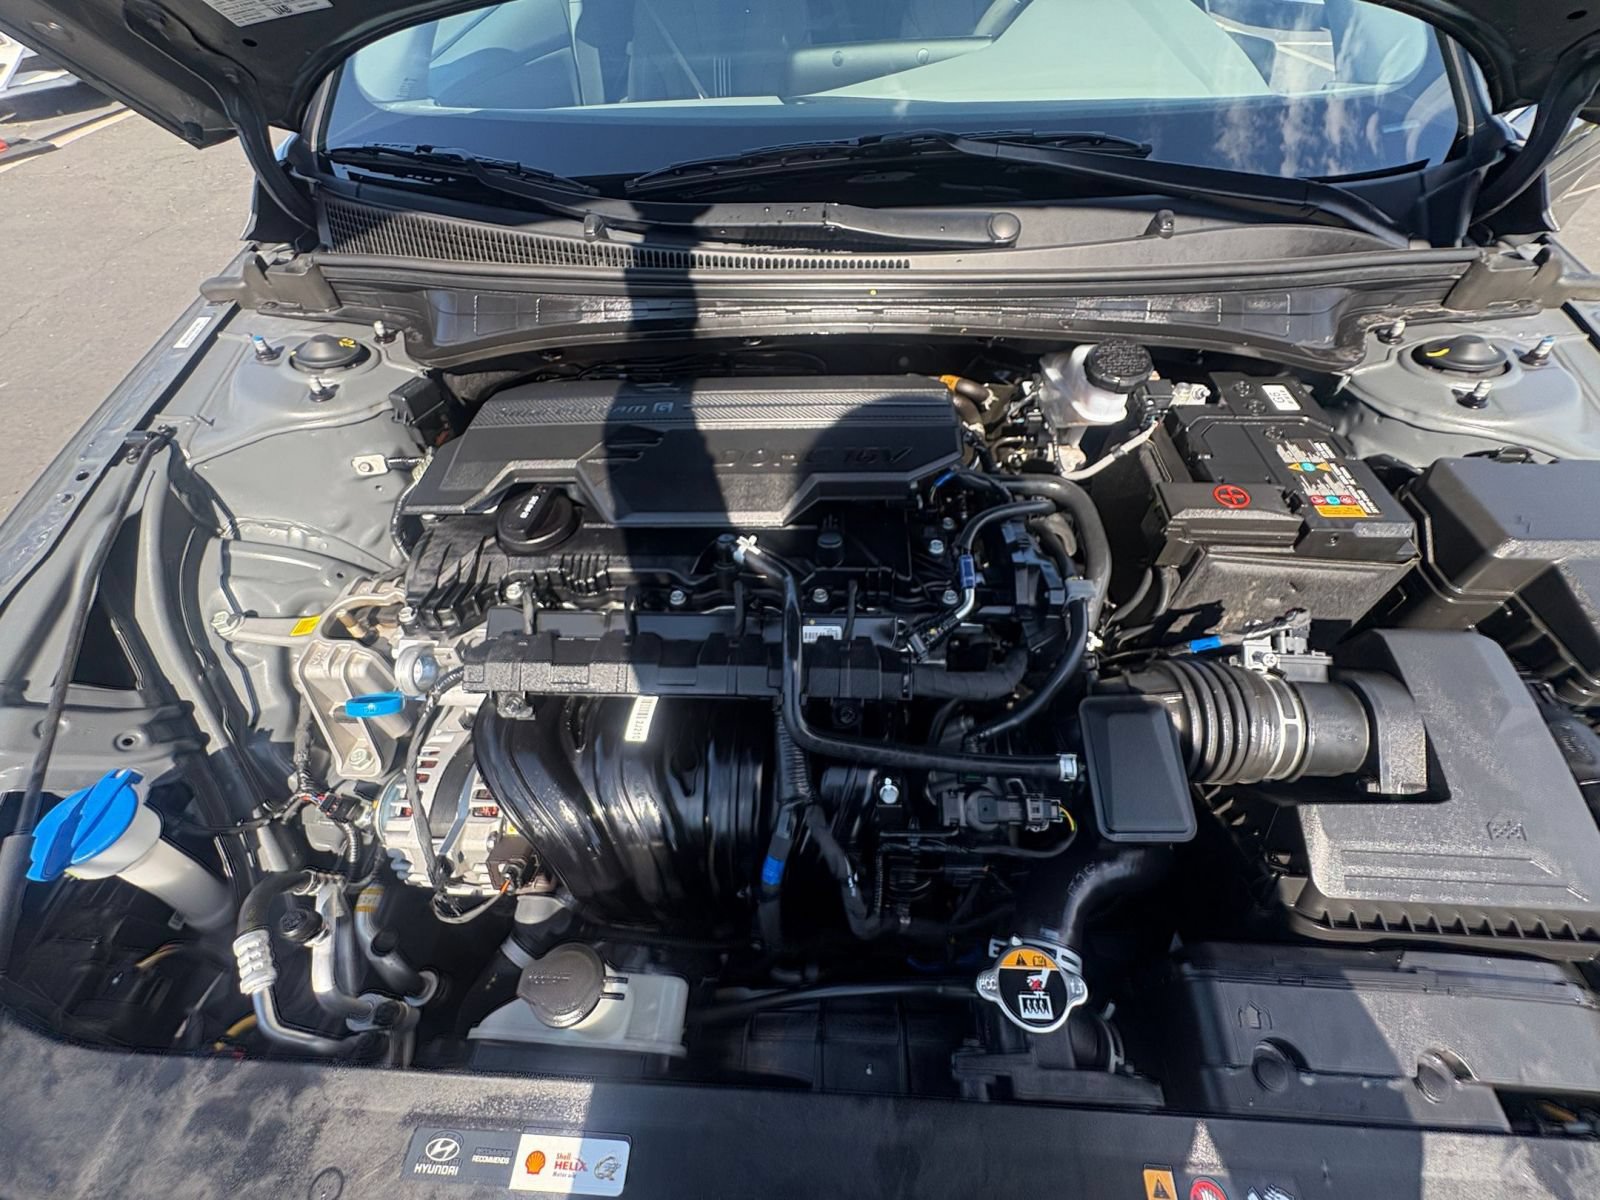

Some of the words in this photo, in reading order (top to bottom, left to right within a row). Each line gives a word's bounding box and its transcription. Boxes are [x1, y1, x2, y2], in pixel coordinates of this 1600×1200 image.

[472, 1155, 510, 1164] RECOMMENDS
[556, 1152, 571, 1160] Shell
[414, 1163, 459, 1176] HYUNDAI
[554, 1158, 588, 1172] HELIX
